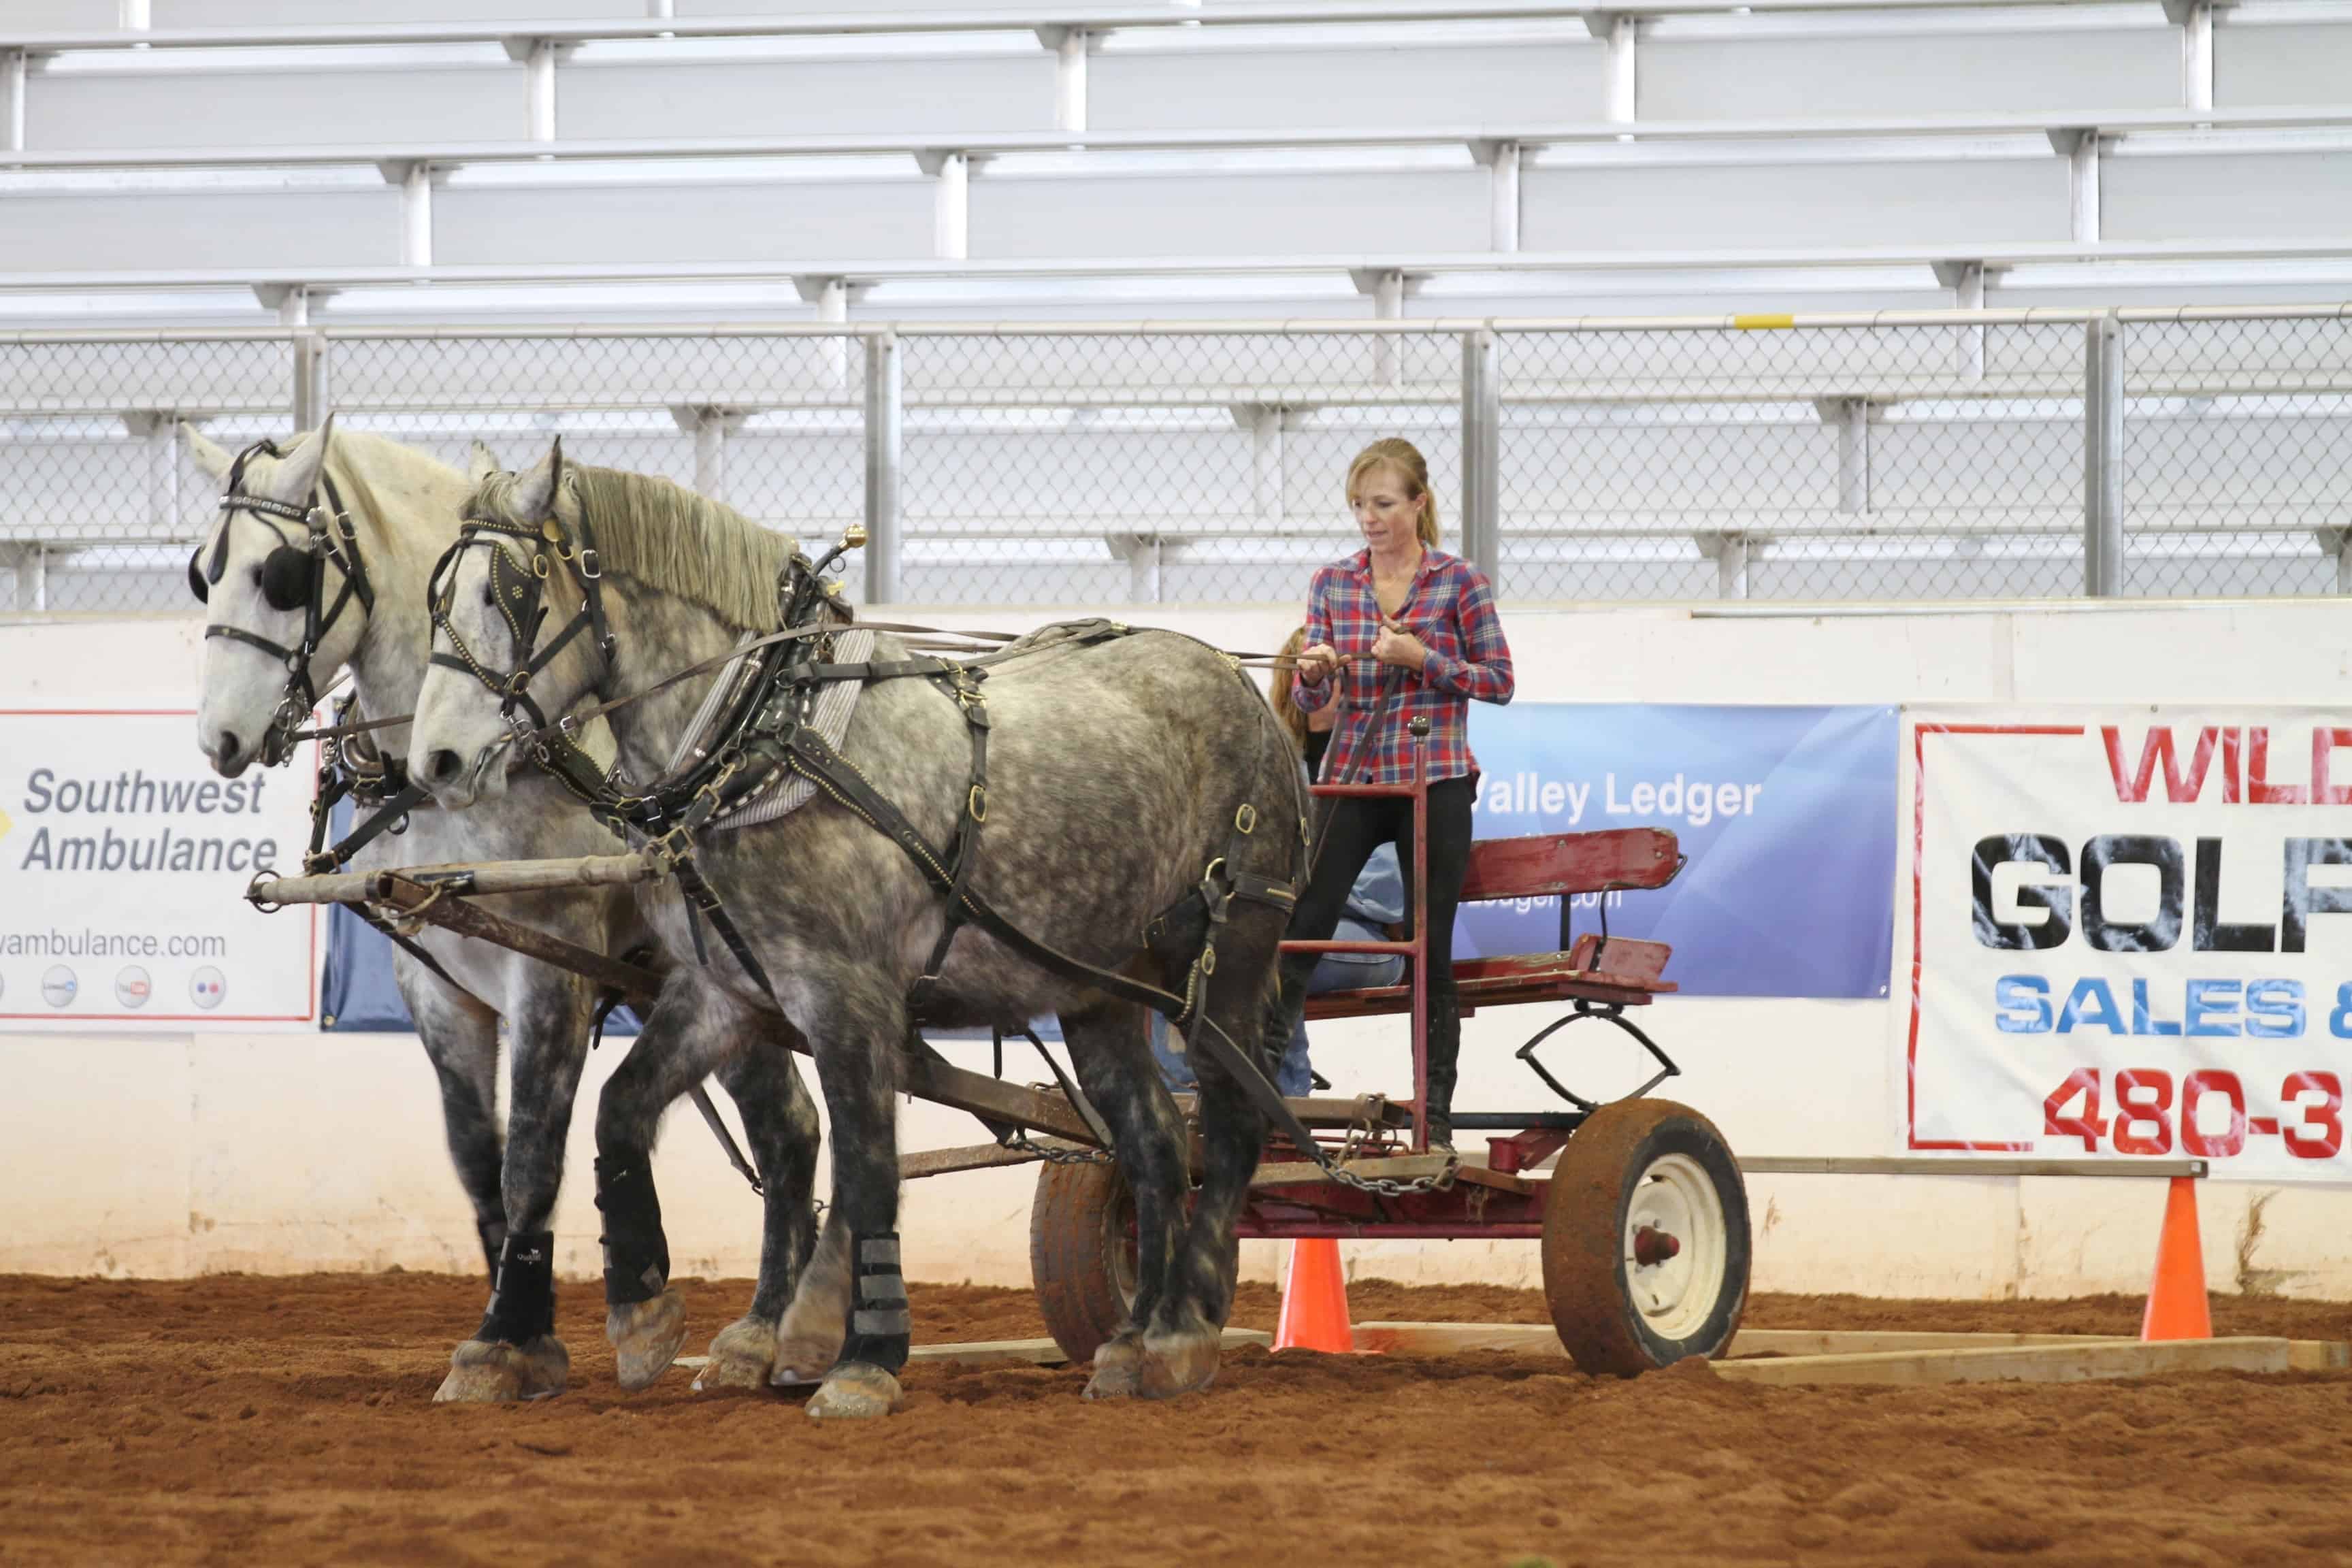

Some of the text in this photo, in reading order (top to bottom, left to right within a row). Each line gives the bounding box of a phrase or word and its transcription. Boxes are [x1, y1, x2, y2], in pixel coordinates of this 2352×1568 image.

[23, 767, 265, 815] Southwest
[1605, 772, 1761, 826] Ledger
[21, 826, 277, 872] Ambulance
[1972, 832, 2352, 953] GOLF
[0, 928, 227, 957] ambulance.com
[1995, 974, 2306, 1039] SALES
